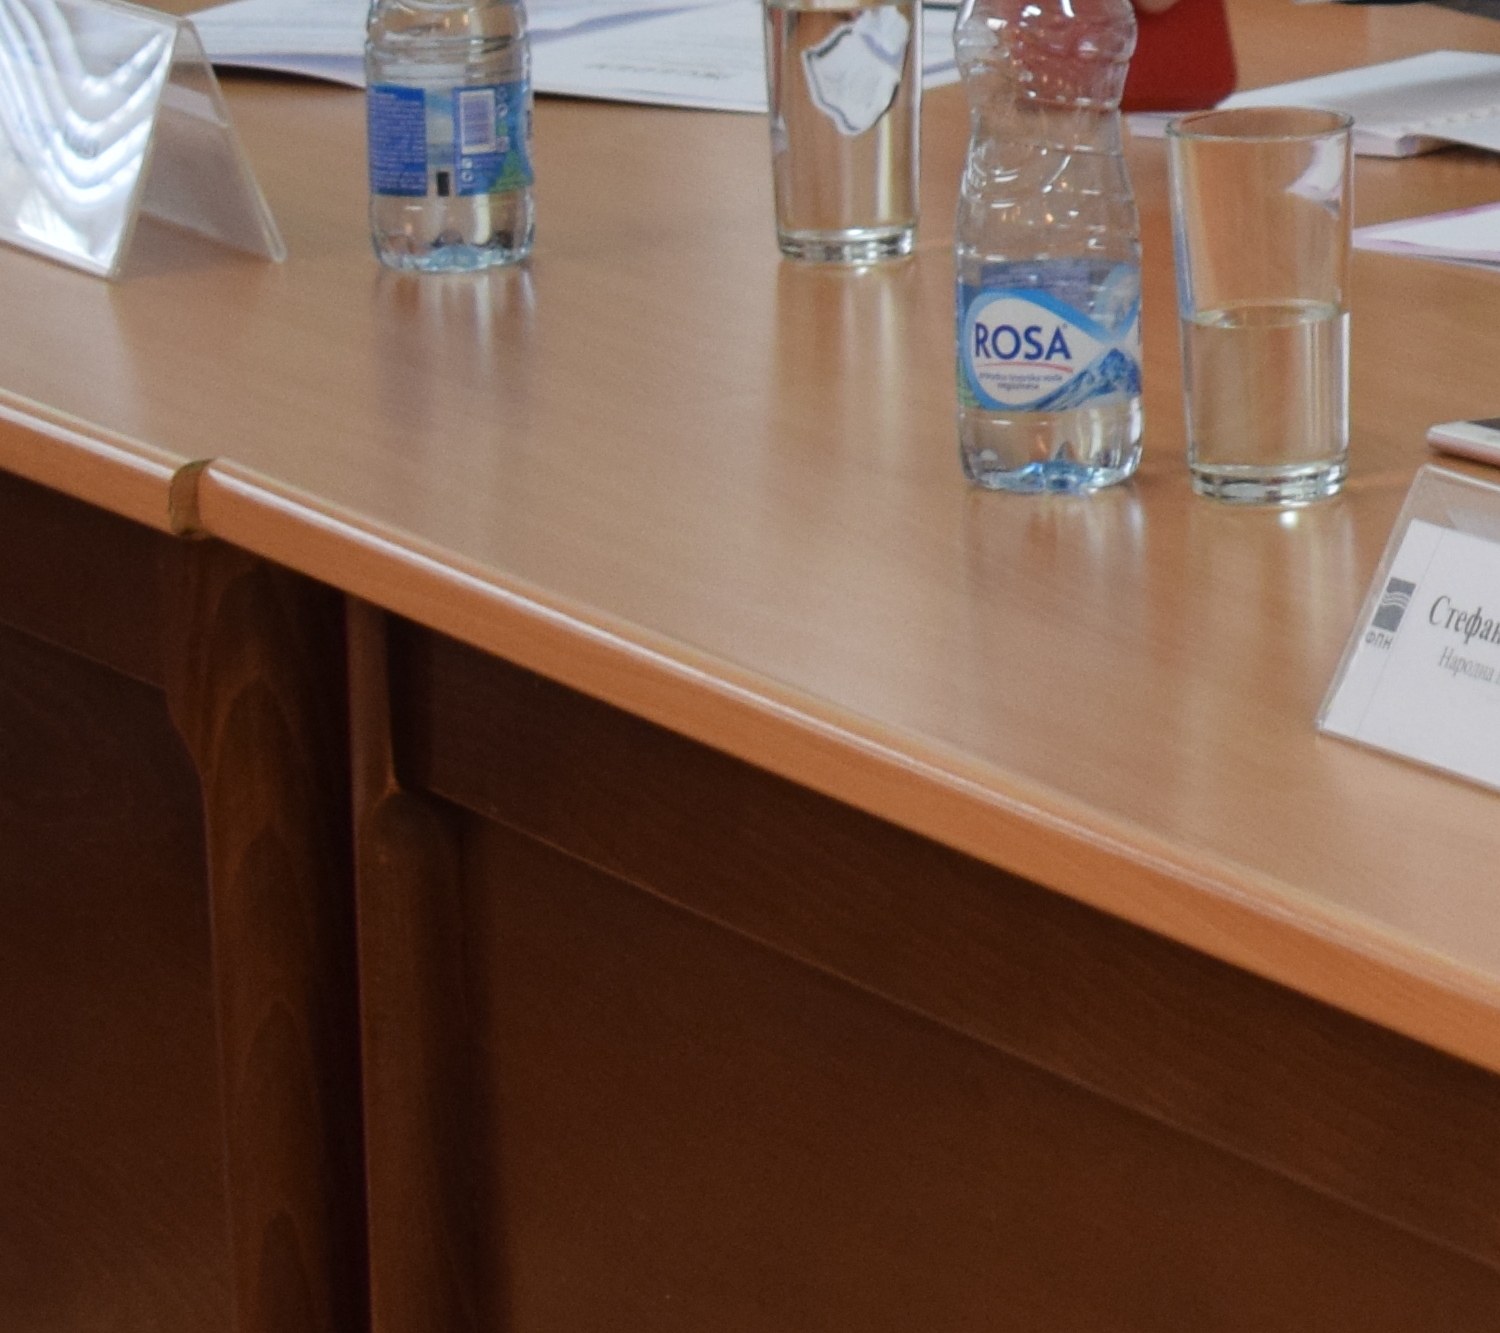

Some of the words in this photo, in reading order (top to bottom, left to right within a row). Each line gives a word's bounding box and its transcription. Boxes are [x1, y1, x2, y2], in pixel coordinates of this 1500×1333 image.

[975, 322, 1071, 360] ROSA
[1365, 631, 1393, 650] ФПН
[1438, 646, 1494, 681] Народна
